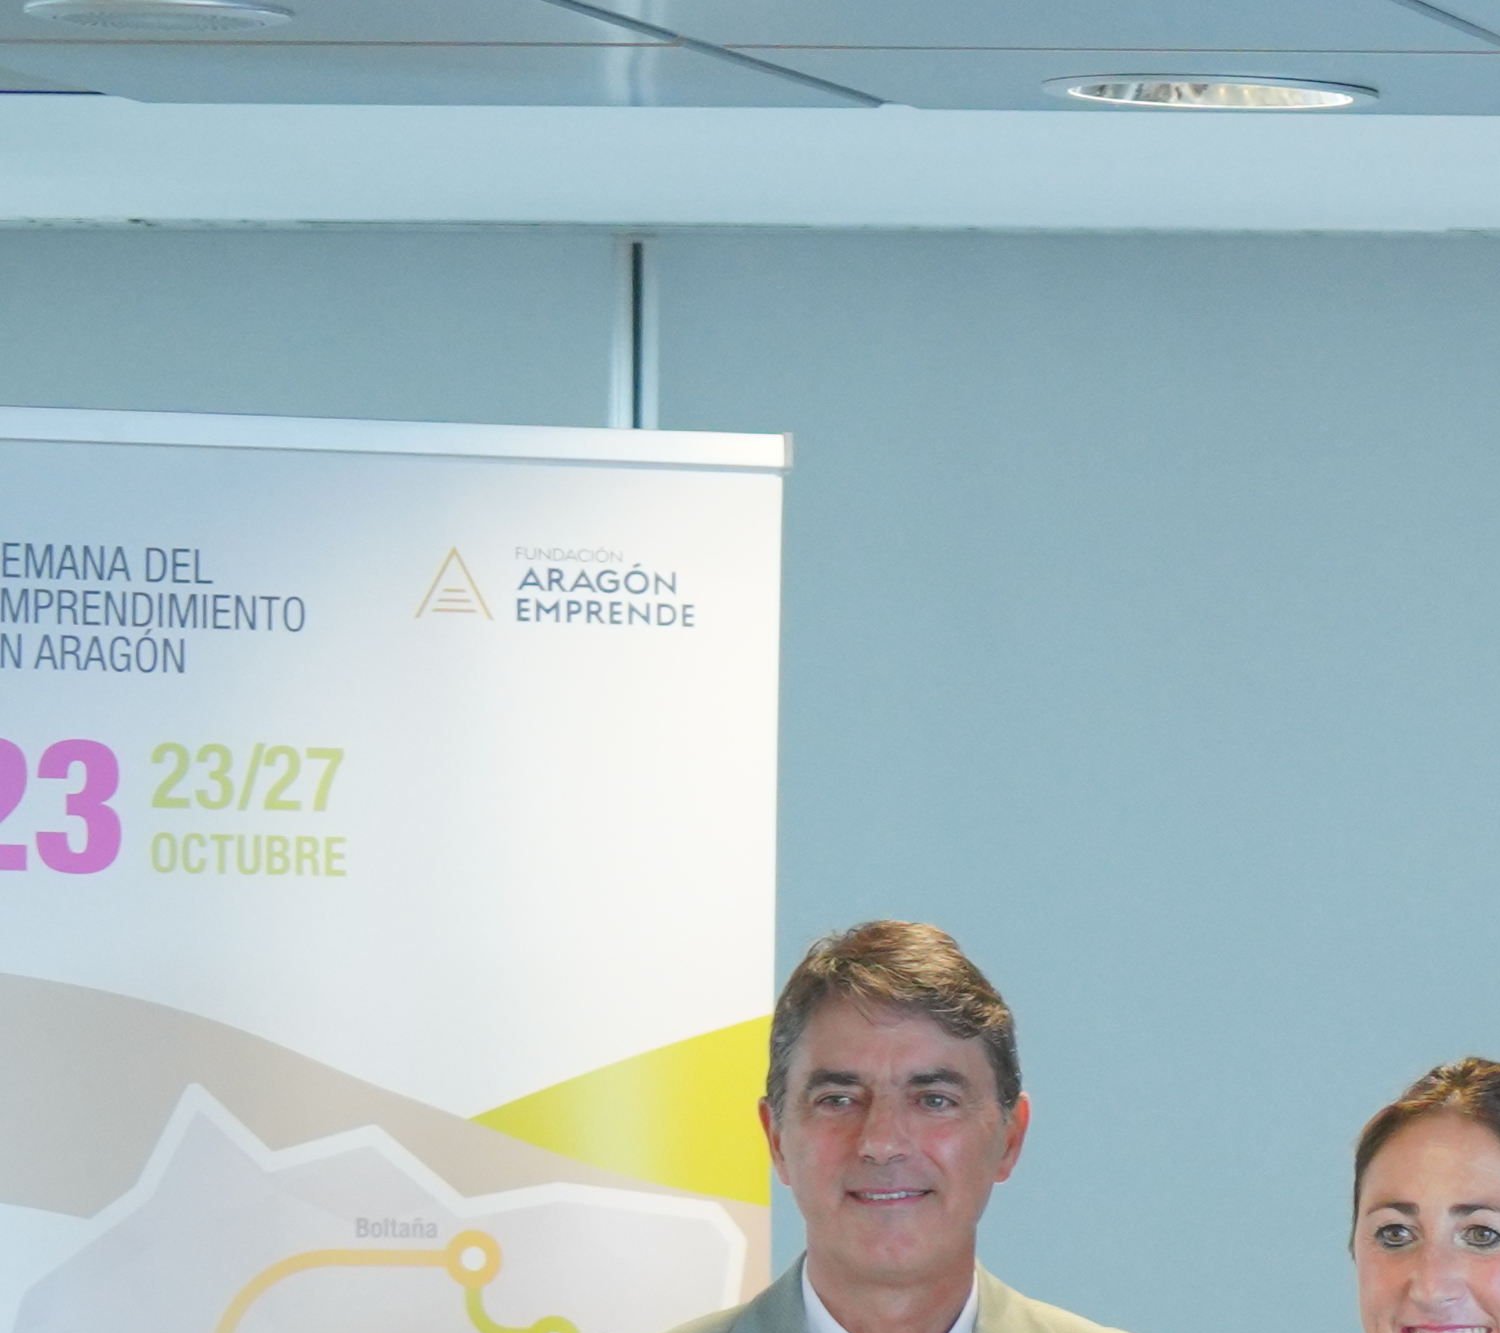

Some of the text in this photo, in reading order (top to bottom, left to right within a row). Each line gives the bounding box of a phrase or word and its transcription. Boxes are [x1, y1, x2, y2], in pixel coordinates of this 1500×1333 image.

[1, 542, 214, 584] EMANA DEL
[514, 546, 624, 563] FUNDACIÓN
[516, 563, 678, 596] ARAGÓN
[0, 587, 306, 632] MPRENDIMIENTO
[516, 598, 696, 628] EMPRENDE
[0, 629, 186, 674] N ARAGÓN
[151, 742, 345, 812] 23/27
[151, 831, 347, 877] OCTUBRE
[355, 1218, 438, 1239] Boltaña
